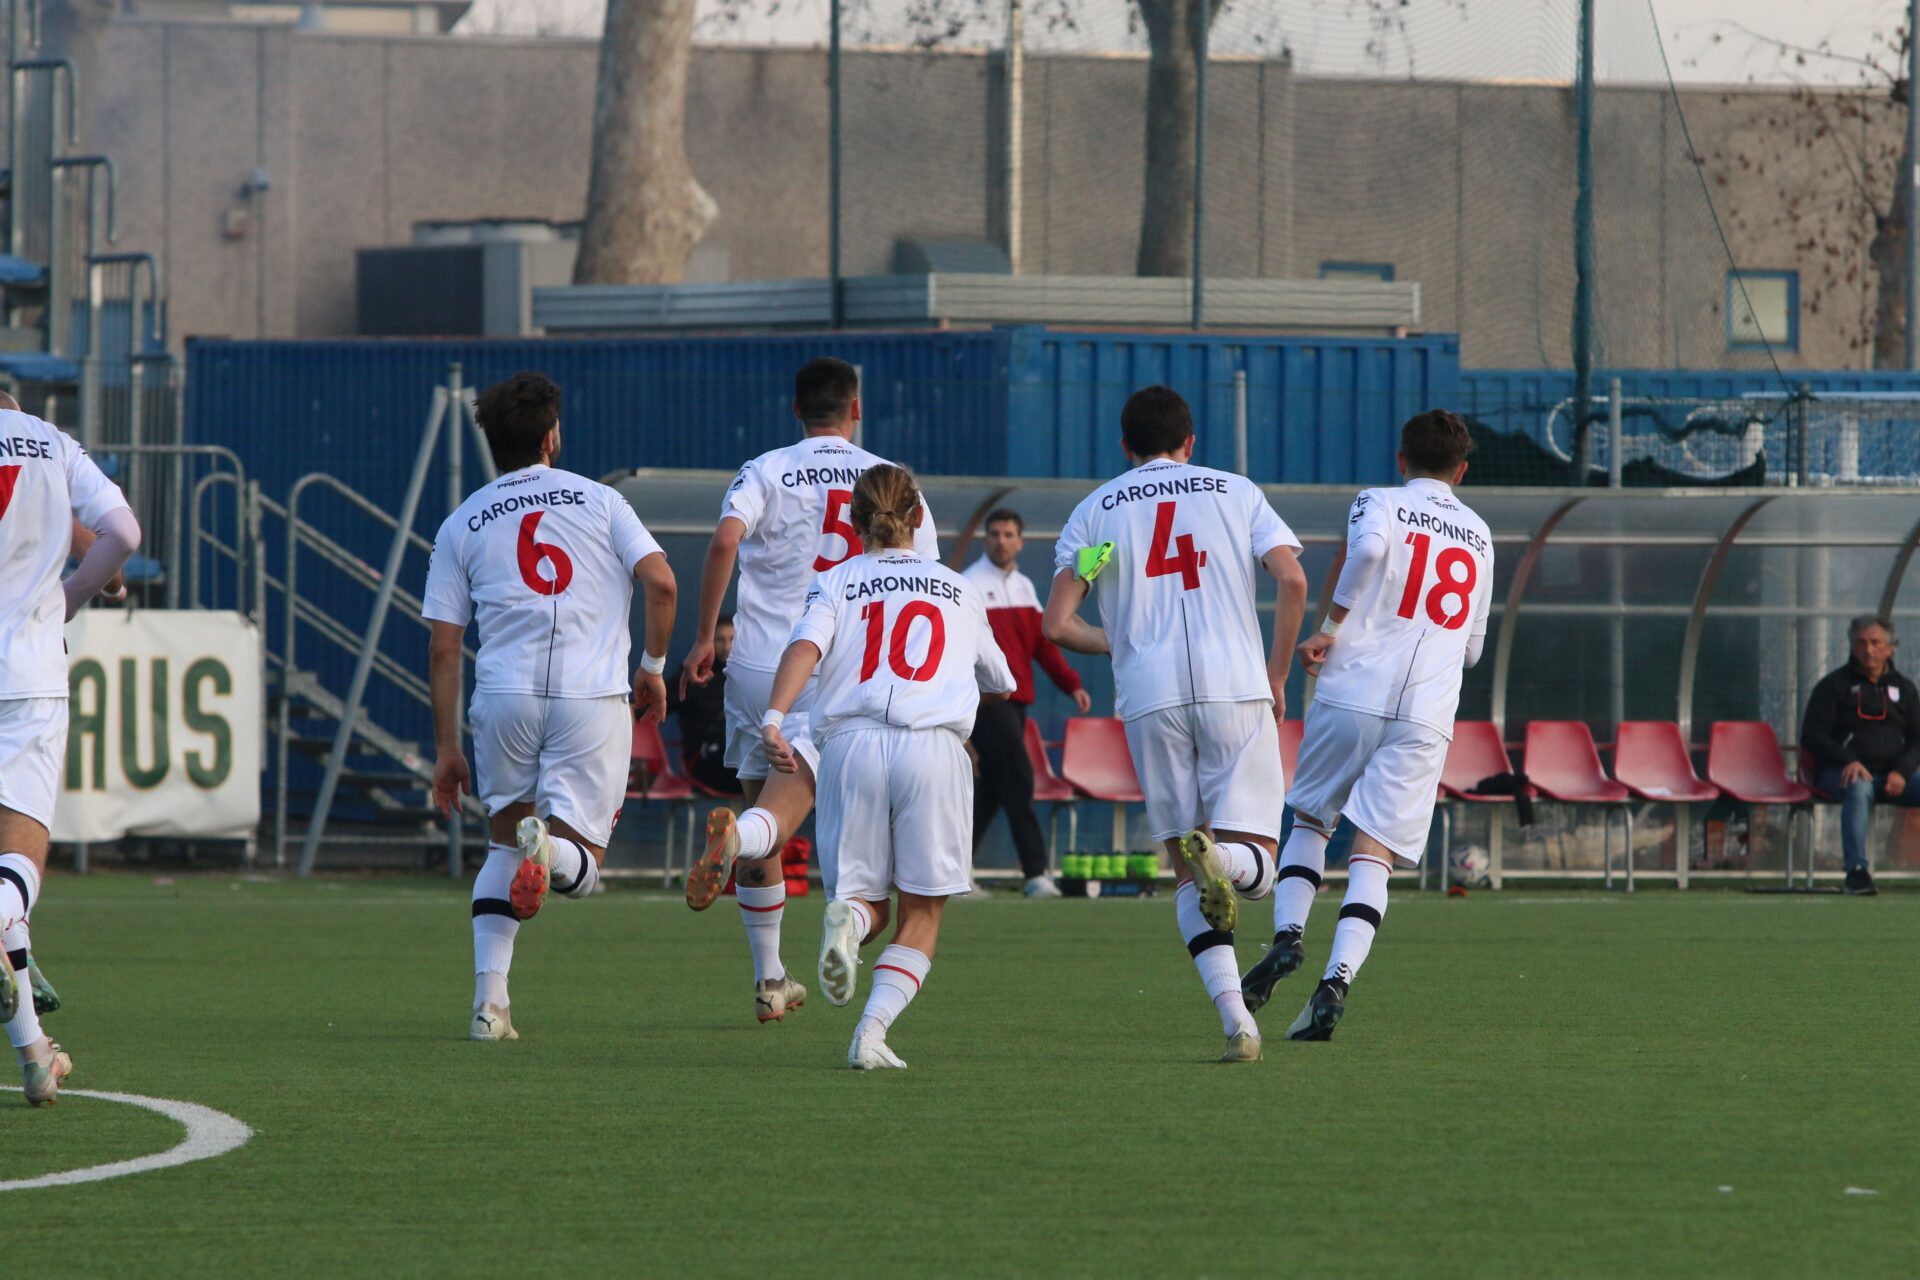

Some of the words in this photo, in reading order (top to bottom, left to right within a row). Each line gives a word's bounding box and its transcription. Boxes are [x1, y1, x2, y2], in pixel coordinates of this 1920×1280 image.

[467, 489, 586, 532] CARONNESE
[781, 467, 866, 488] CARONN
[1101, 477, 1228, 511] CARONNESE
[516, 511, 574, 596] 6
[812, 489, 864, 573] 5
[1145, 501, 1207, 591] 4
[1397, 507, 1488, 559] CARONNESE
[845, 576, 962, 607] CARONNESE
[1397, 531, 1477, 630] 18
[859, 600, 946, 684] 10
[64, 655, 233, 793] AUS
